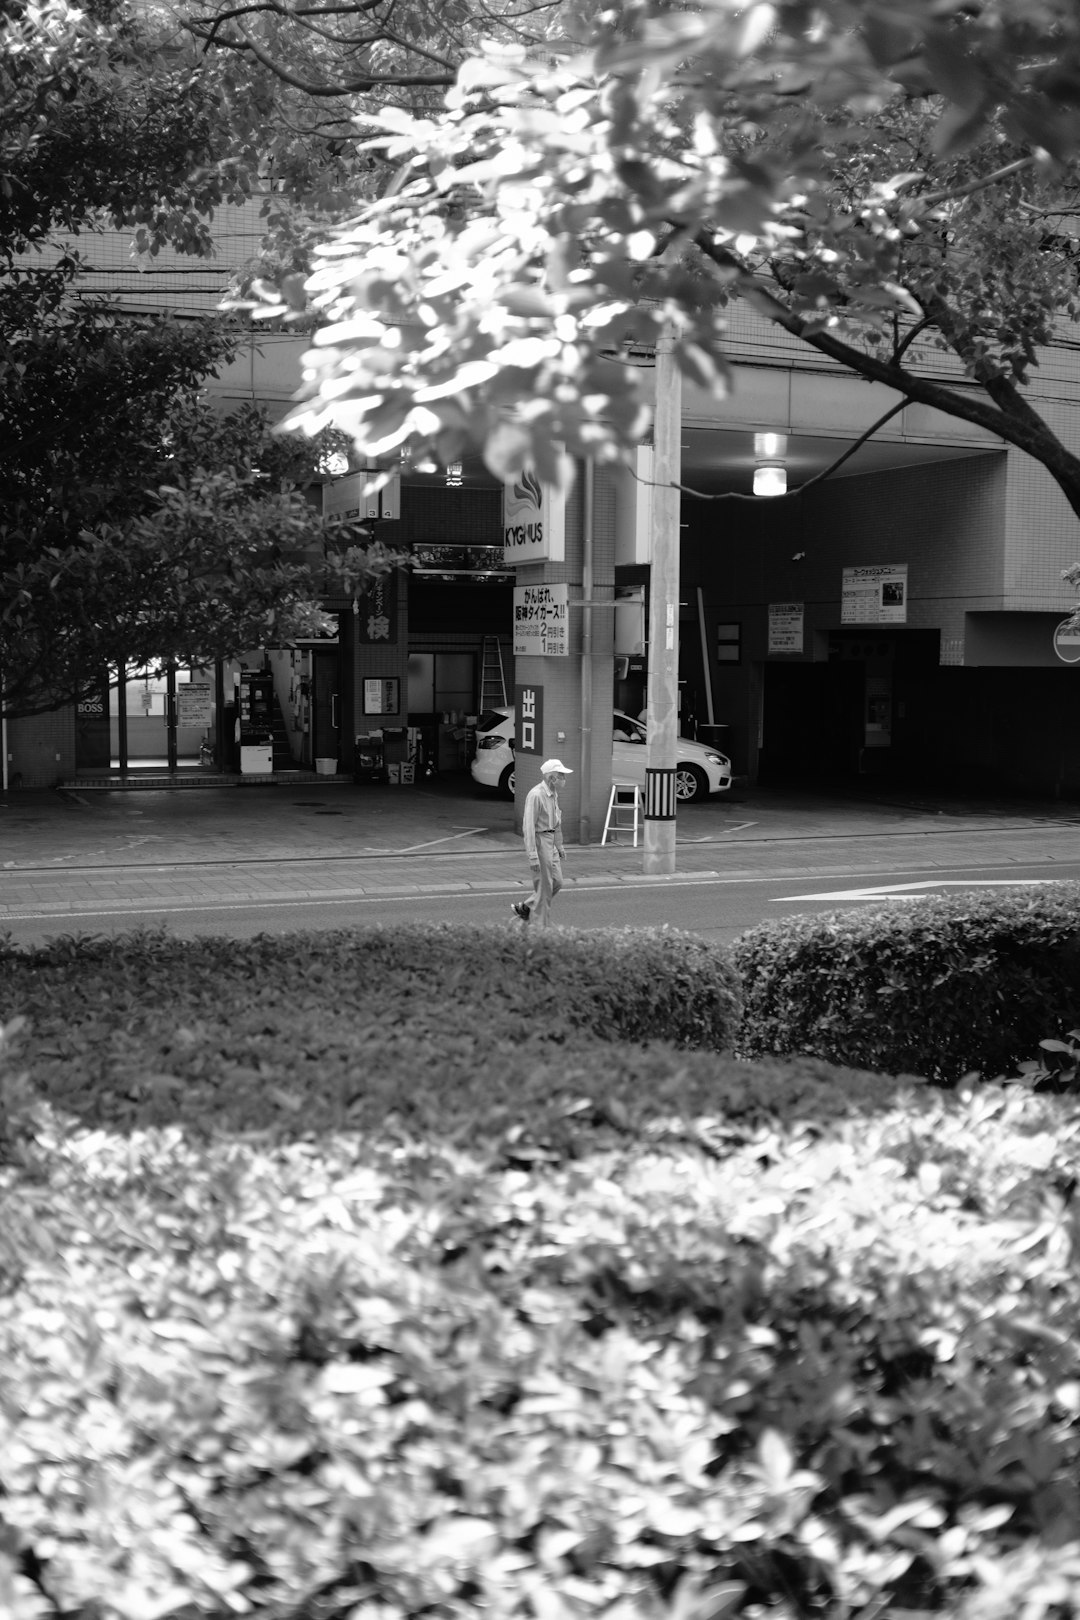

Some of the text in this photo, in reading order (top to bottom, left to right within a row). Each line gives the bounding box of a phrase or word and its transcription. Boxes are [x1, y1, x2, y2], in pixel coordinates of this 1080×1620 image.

[505, 522, 543, 547] KYGNUS
[367, 616, 390, 640] 検
[77, 703, 104, 713] BOSS
[522, 689, 535, 749] 出口
